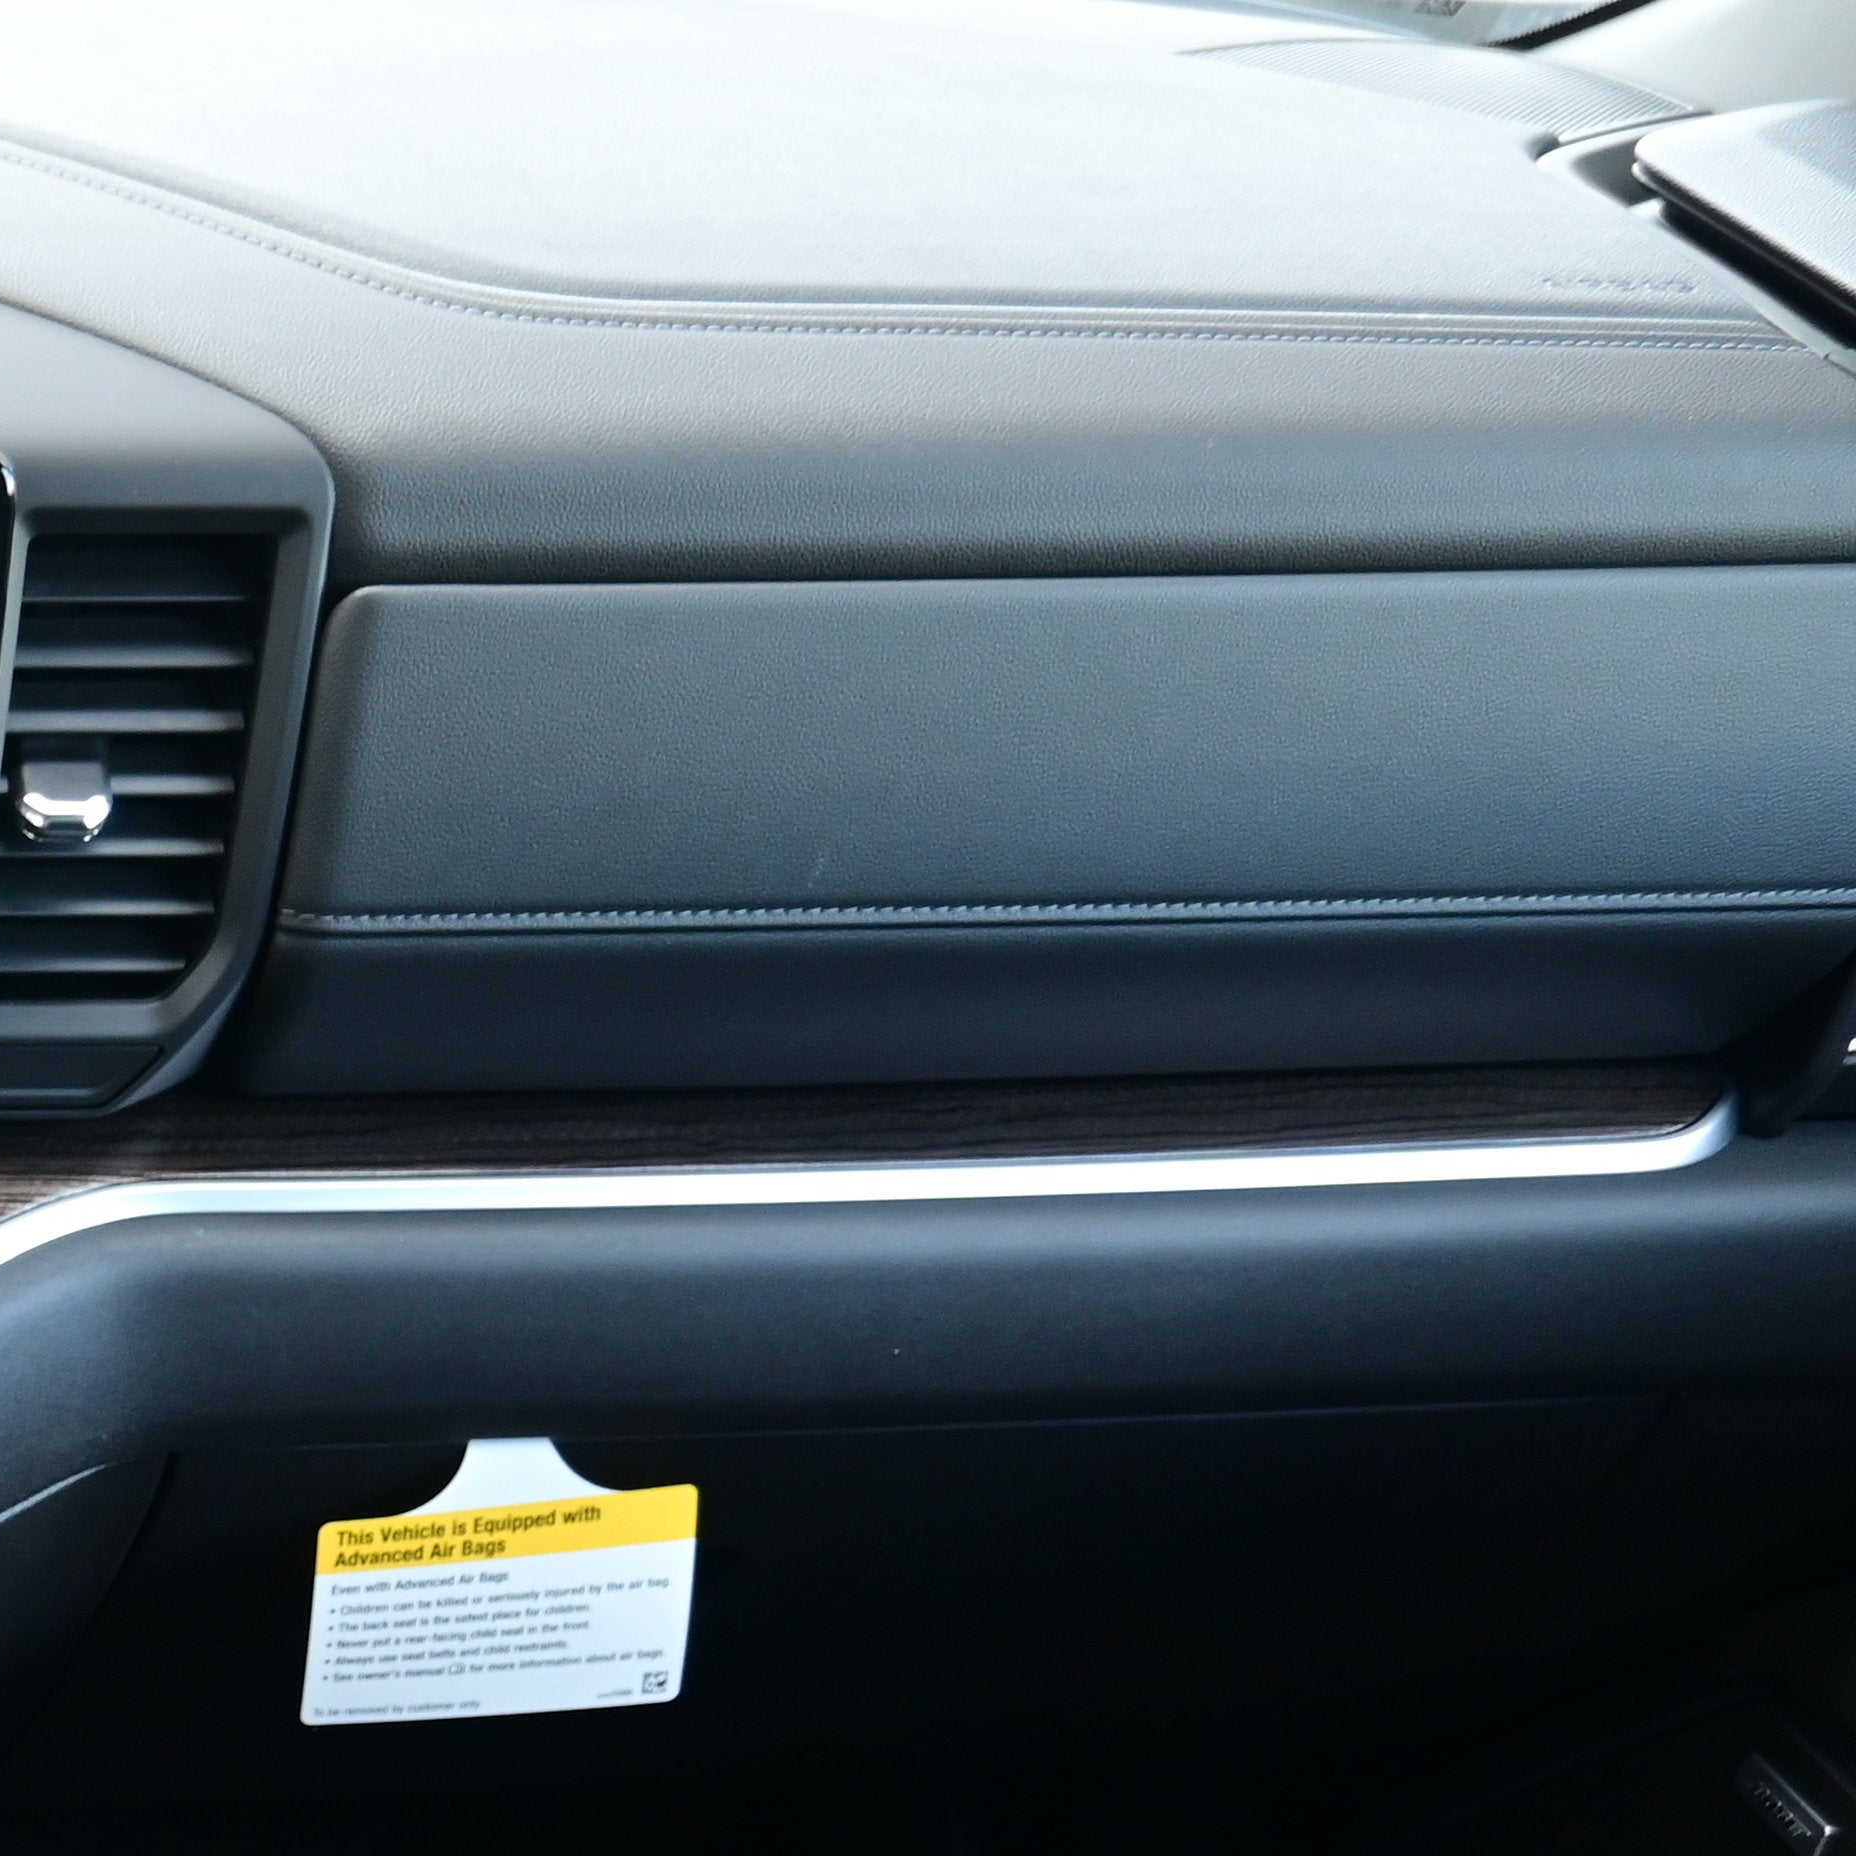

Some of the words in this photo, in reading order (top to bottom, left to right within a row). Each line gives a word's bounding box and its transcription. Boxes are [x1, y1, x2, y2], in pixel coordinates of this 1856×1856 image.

[337, 1530, 374, 1547] This
[381, 1521, 446, 1543] Vehicle
[452, 1519, 467, 1536] is
[473, 1509, 556, 1534] Equipped
[563, 1506, 601, 1525] with
[335, 1547, 423, 1568] Advanced
[430, 1543, 456, 1560] Air
[462, 1539, 506, 1560] Bags
[331, 1583, 361, 1597] Even
[365, 1581, 391, 1594] with
[395, 1576, 455, 1591] Advanced
[458, 1573, 474, 1585] Air
